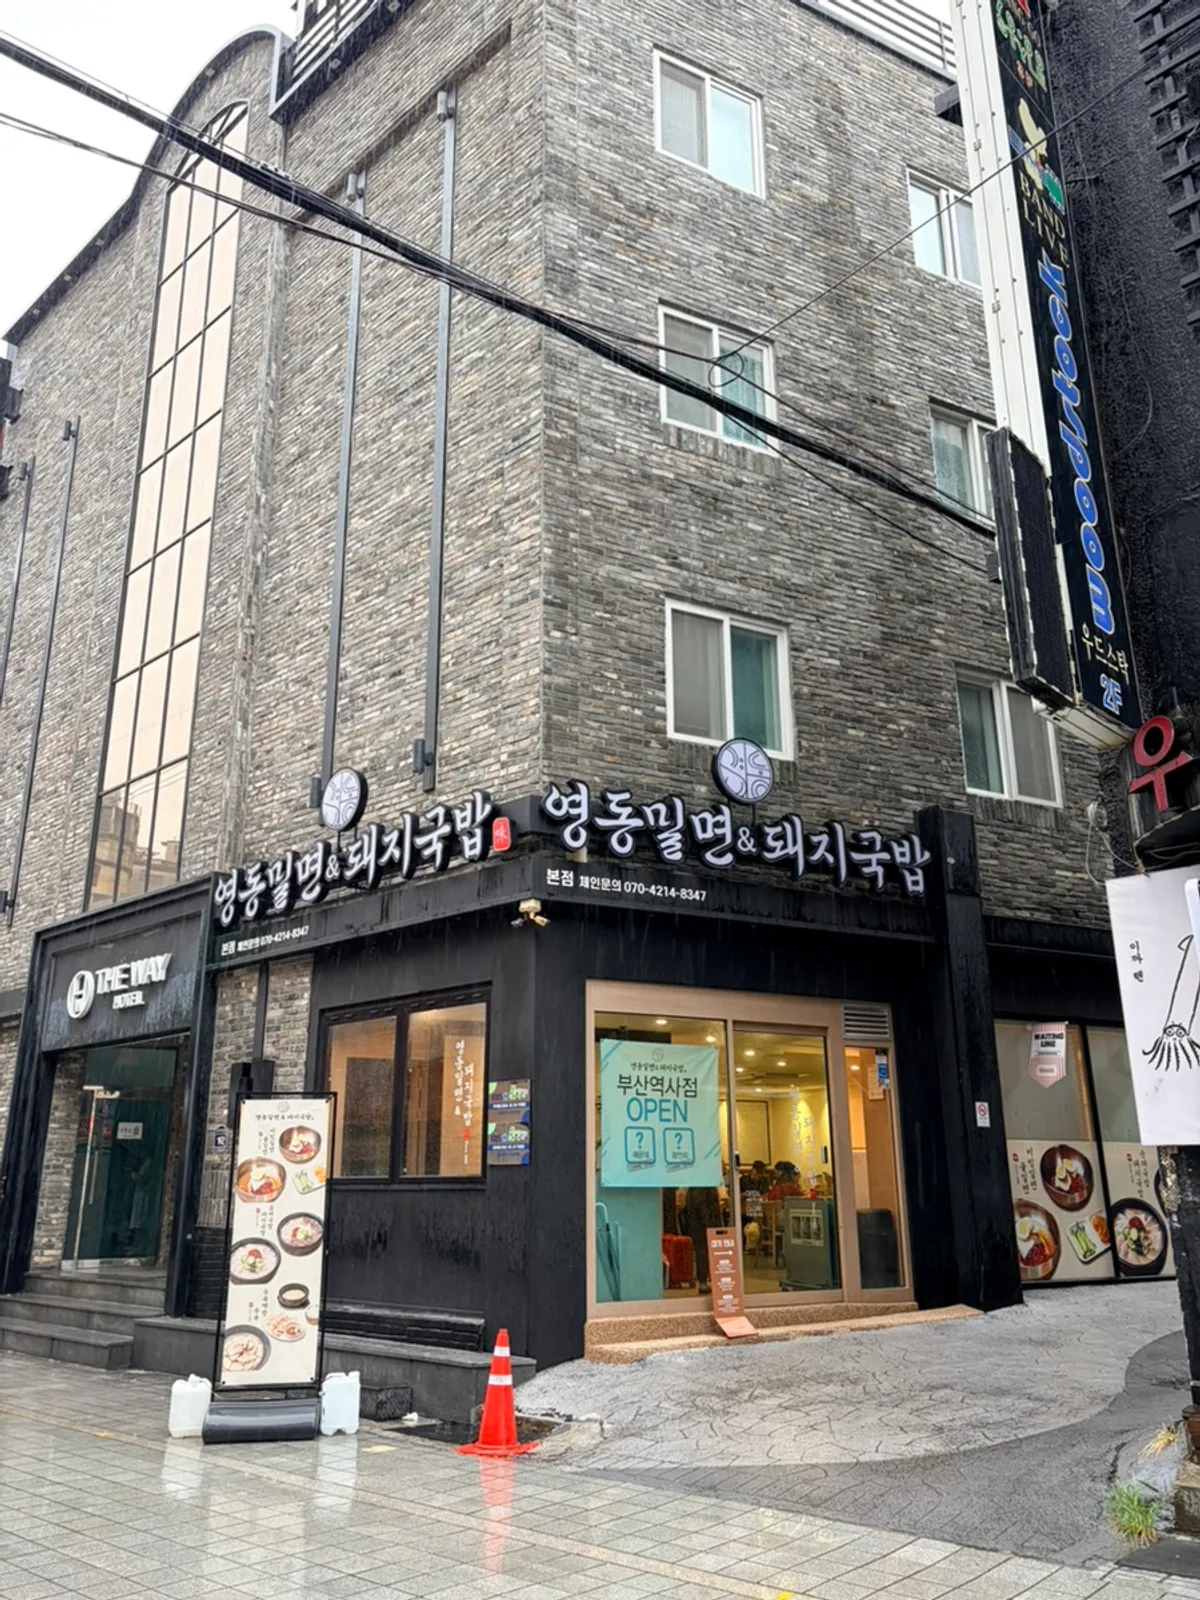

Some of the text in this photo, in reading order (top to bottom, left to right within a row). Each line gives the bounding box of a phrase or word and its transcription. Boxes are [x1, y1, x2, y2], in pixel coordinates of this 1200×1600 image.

[1018, 168, 1066, 239] BAND
[1022, 196, 1070, 268] LIVE
[1037, 247, 1116, 636] woodstock
[1081, 621, 1130, 686] 우드스탁
[547, 868, 707, 901] 본점 체인문의 070-4214-8347
[95, 953, 173, 994] THE WAY
[617, 1074, 698, 1098] 부산역사점
[626, 1097, 688, 1122] OPEN
